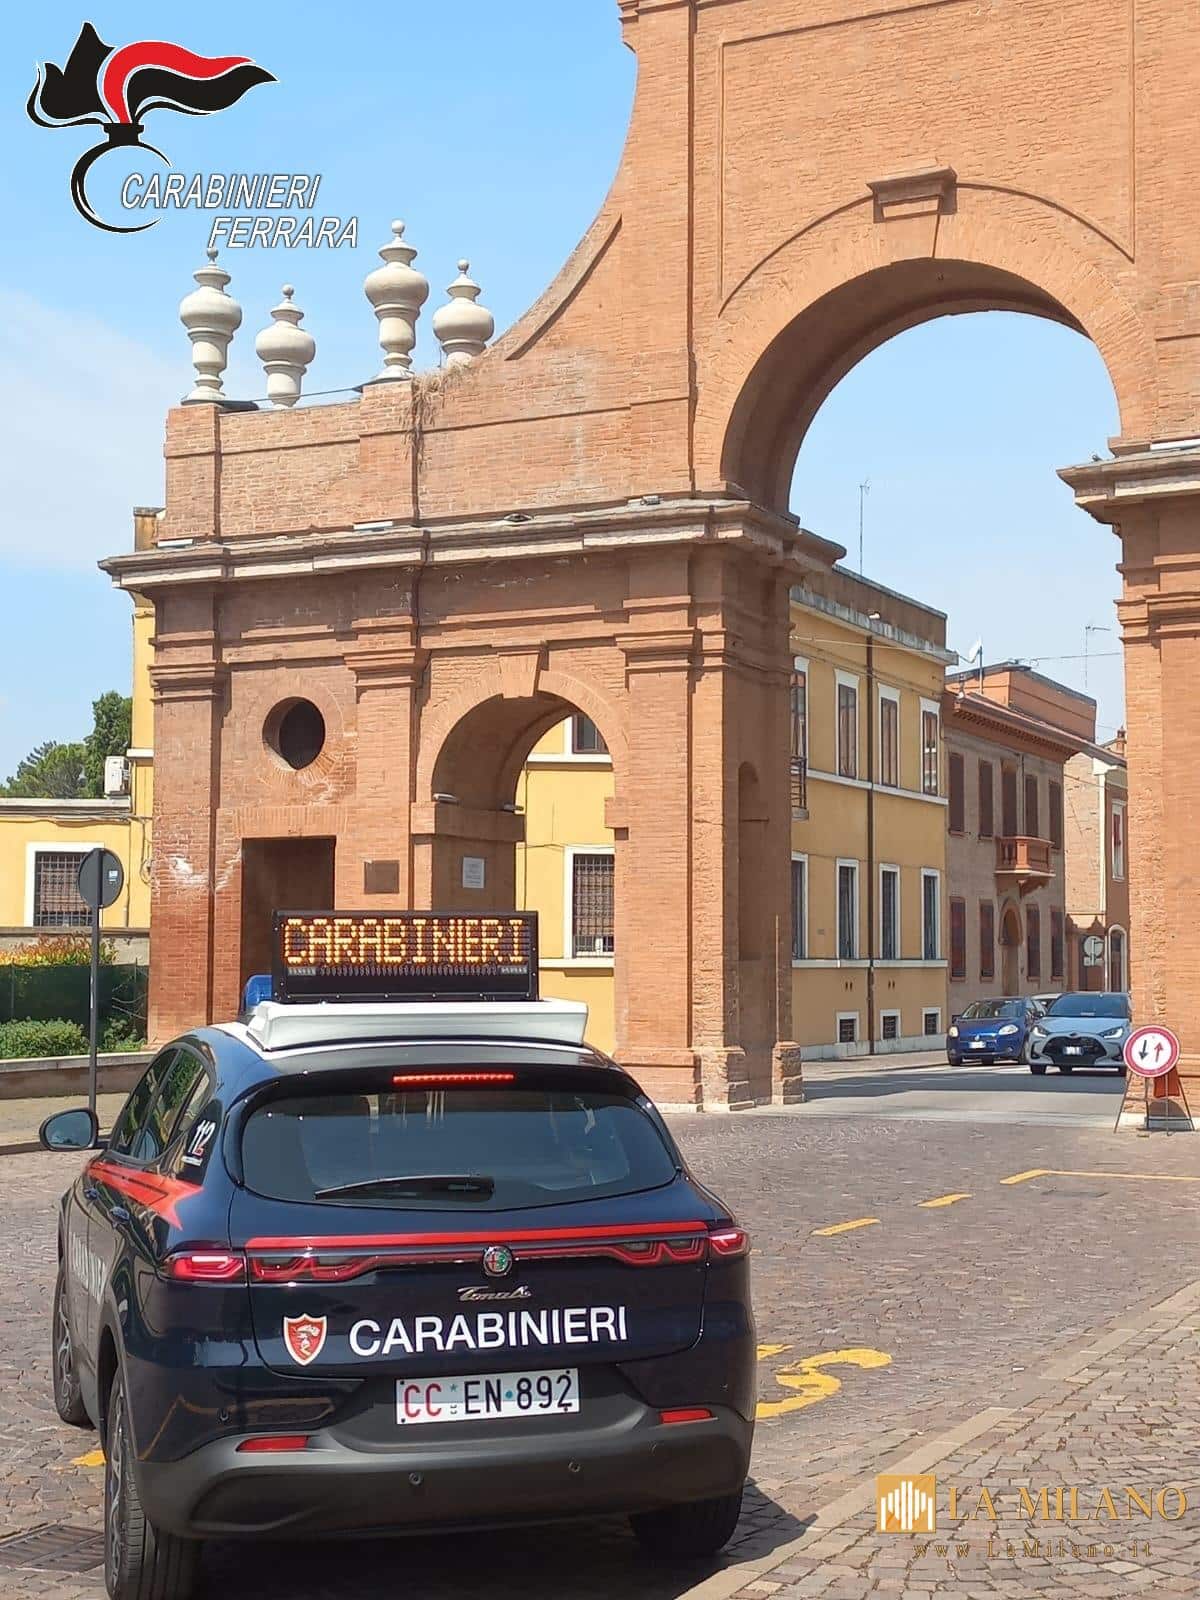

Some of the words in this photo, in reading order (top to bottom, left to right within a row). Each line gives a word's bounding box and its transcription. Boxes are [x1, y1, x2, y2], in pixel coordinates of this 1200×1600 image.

[284, 918, 523, 964] CARABINIERI
[188, 1119, 216, 1156] 112
[349, 1306, 627, 1356] CARABINIERI
[404, 1383, 442, 1418] CC
[463, 1379, 502, 1415] EN
[516, 1375, 573, 1410] 892
